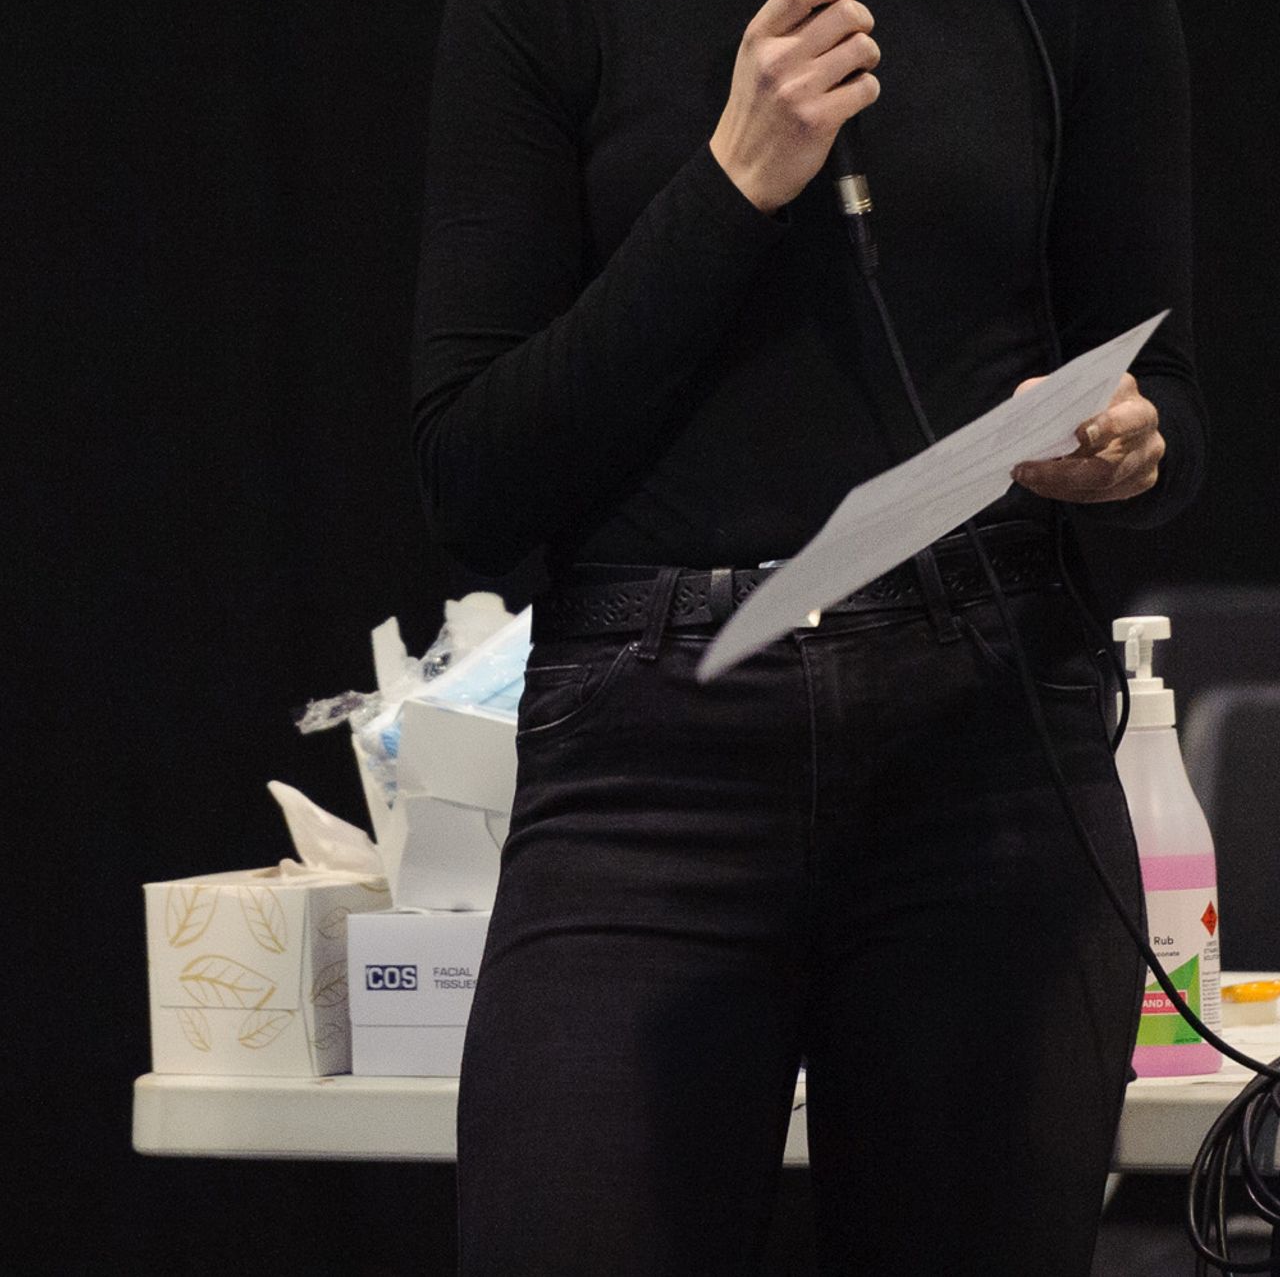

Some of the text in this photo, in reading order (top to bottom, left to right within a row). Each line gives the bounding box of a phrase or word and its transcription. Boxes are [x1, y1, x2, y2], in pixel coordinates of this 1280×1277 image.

[1153, 935, 1174, 945] Rub
[433, 967, 472, 977] FACIAL
[367, 966, 417, 989] COS
[1142, 999, 1164, 1008] AND
